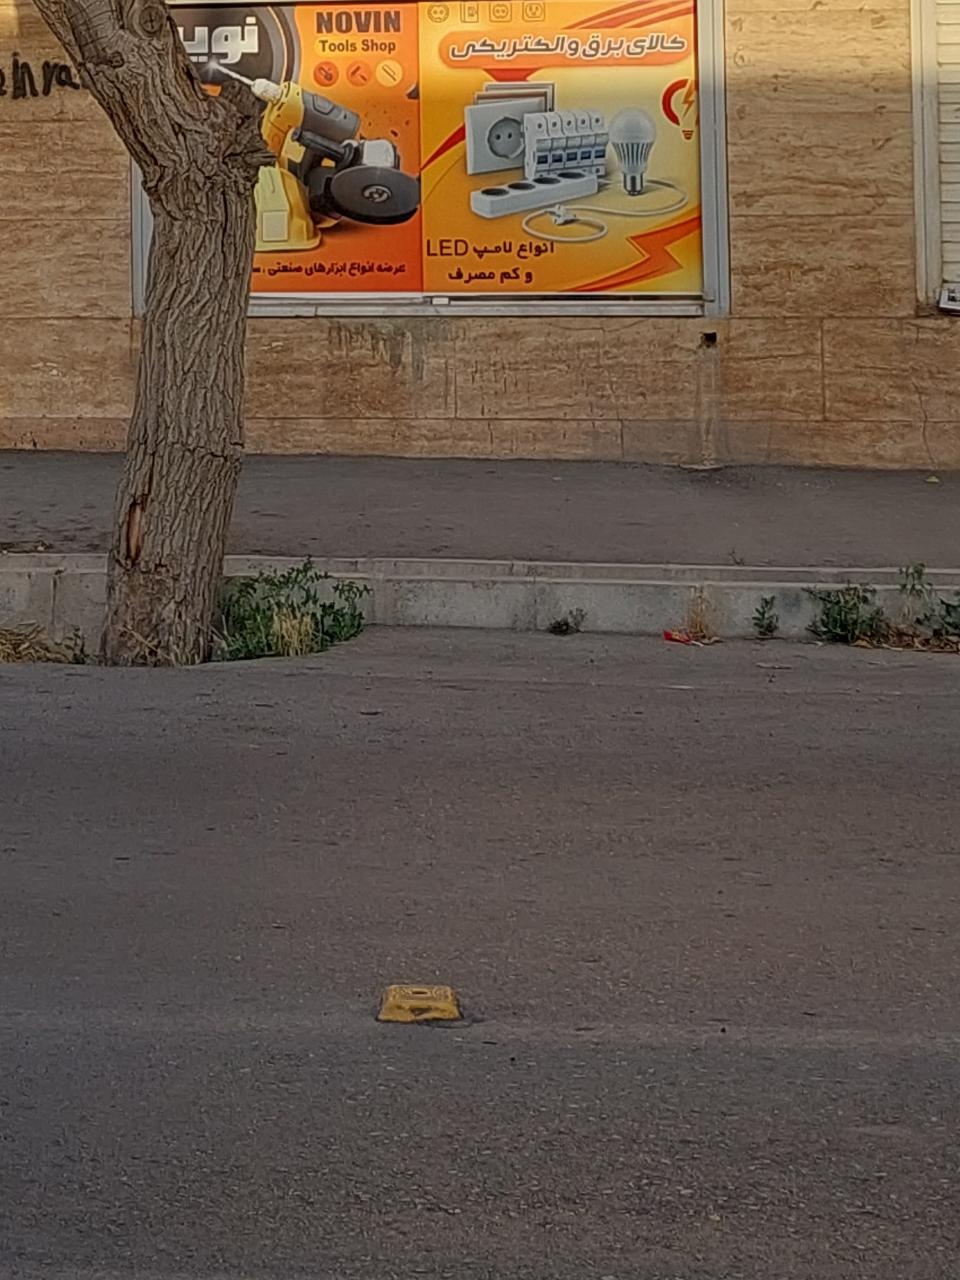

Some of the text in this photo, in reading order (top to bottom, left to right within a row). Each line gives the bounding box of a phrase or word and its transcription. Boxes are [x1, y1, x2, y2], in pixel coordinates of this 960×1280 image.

[315, 10, 401, 34] NOVIN
[177, 16, 259, 64] نوی
[319, 38, 396, 56] Tools Shop
[581, 34, 627, 58] برق
[626, 34, 686, 55] کالای
[426, 239, 555, 260] انواع لامپ LED
[348, 261, 375, 277] انواع
[375, 262, 406, 276] عرضه
[447, 266, 534, 284] و کم مصرف
